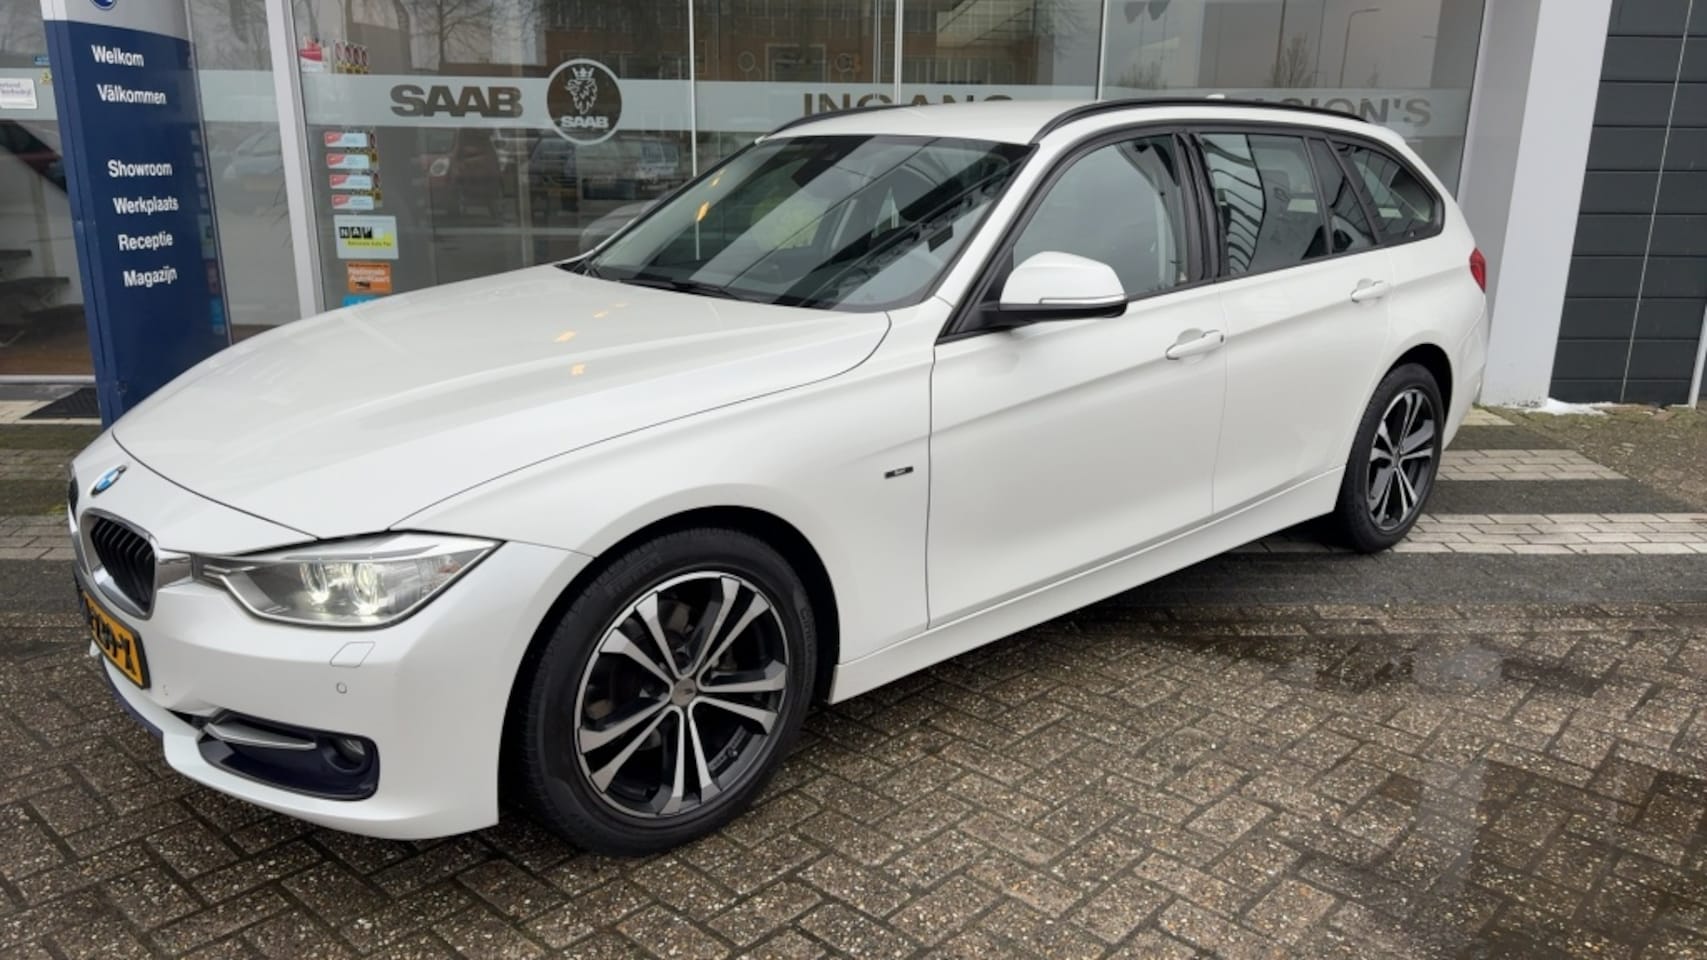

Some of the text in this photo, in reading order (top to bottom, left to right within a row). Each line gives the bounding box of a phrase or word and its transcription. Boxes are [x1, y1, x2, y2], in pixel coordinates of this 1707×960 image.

[91, 44, 144, 67] Welkom
[96, 83, 167, 105] Välkommen
[390, 84, 523, 118] SAAB
[560, 115, 609, 129] SAAB
[107, 160, 173, 178] Showroom
[112, 196, 179, 215] Werkplaats
[118, 230, 173, 251] Receptie
[123, 265, 177, 287] Magazijn
